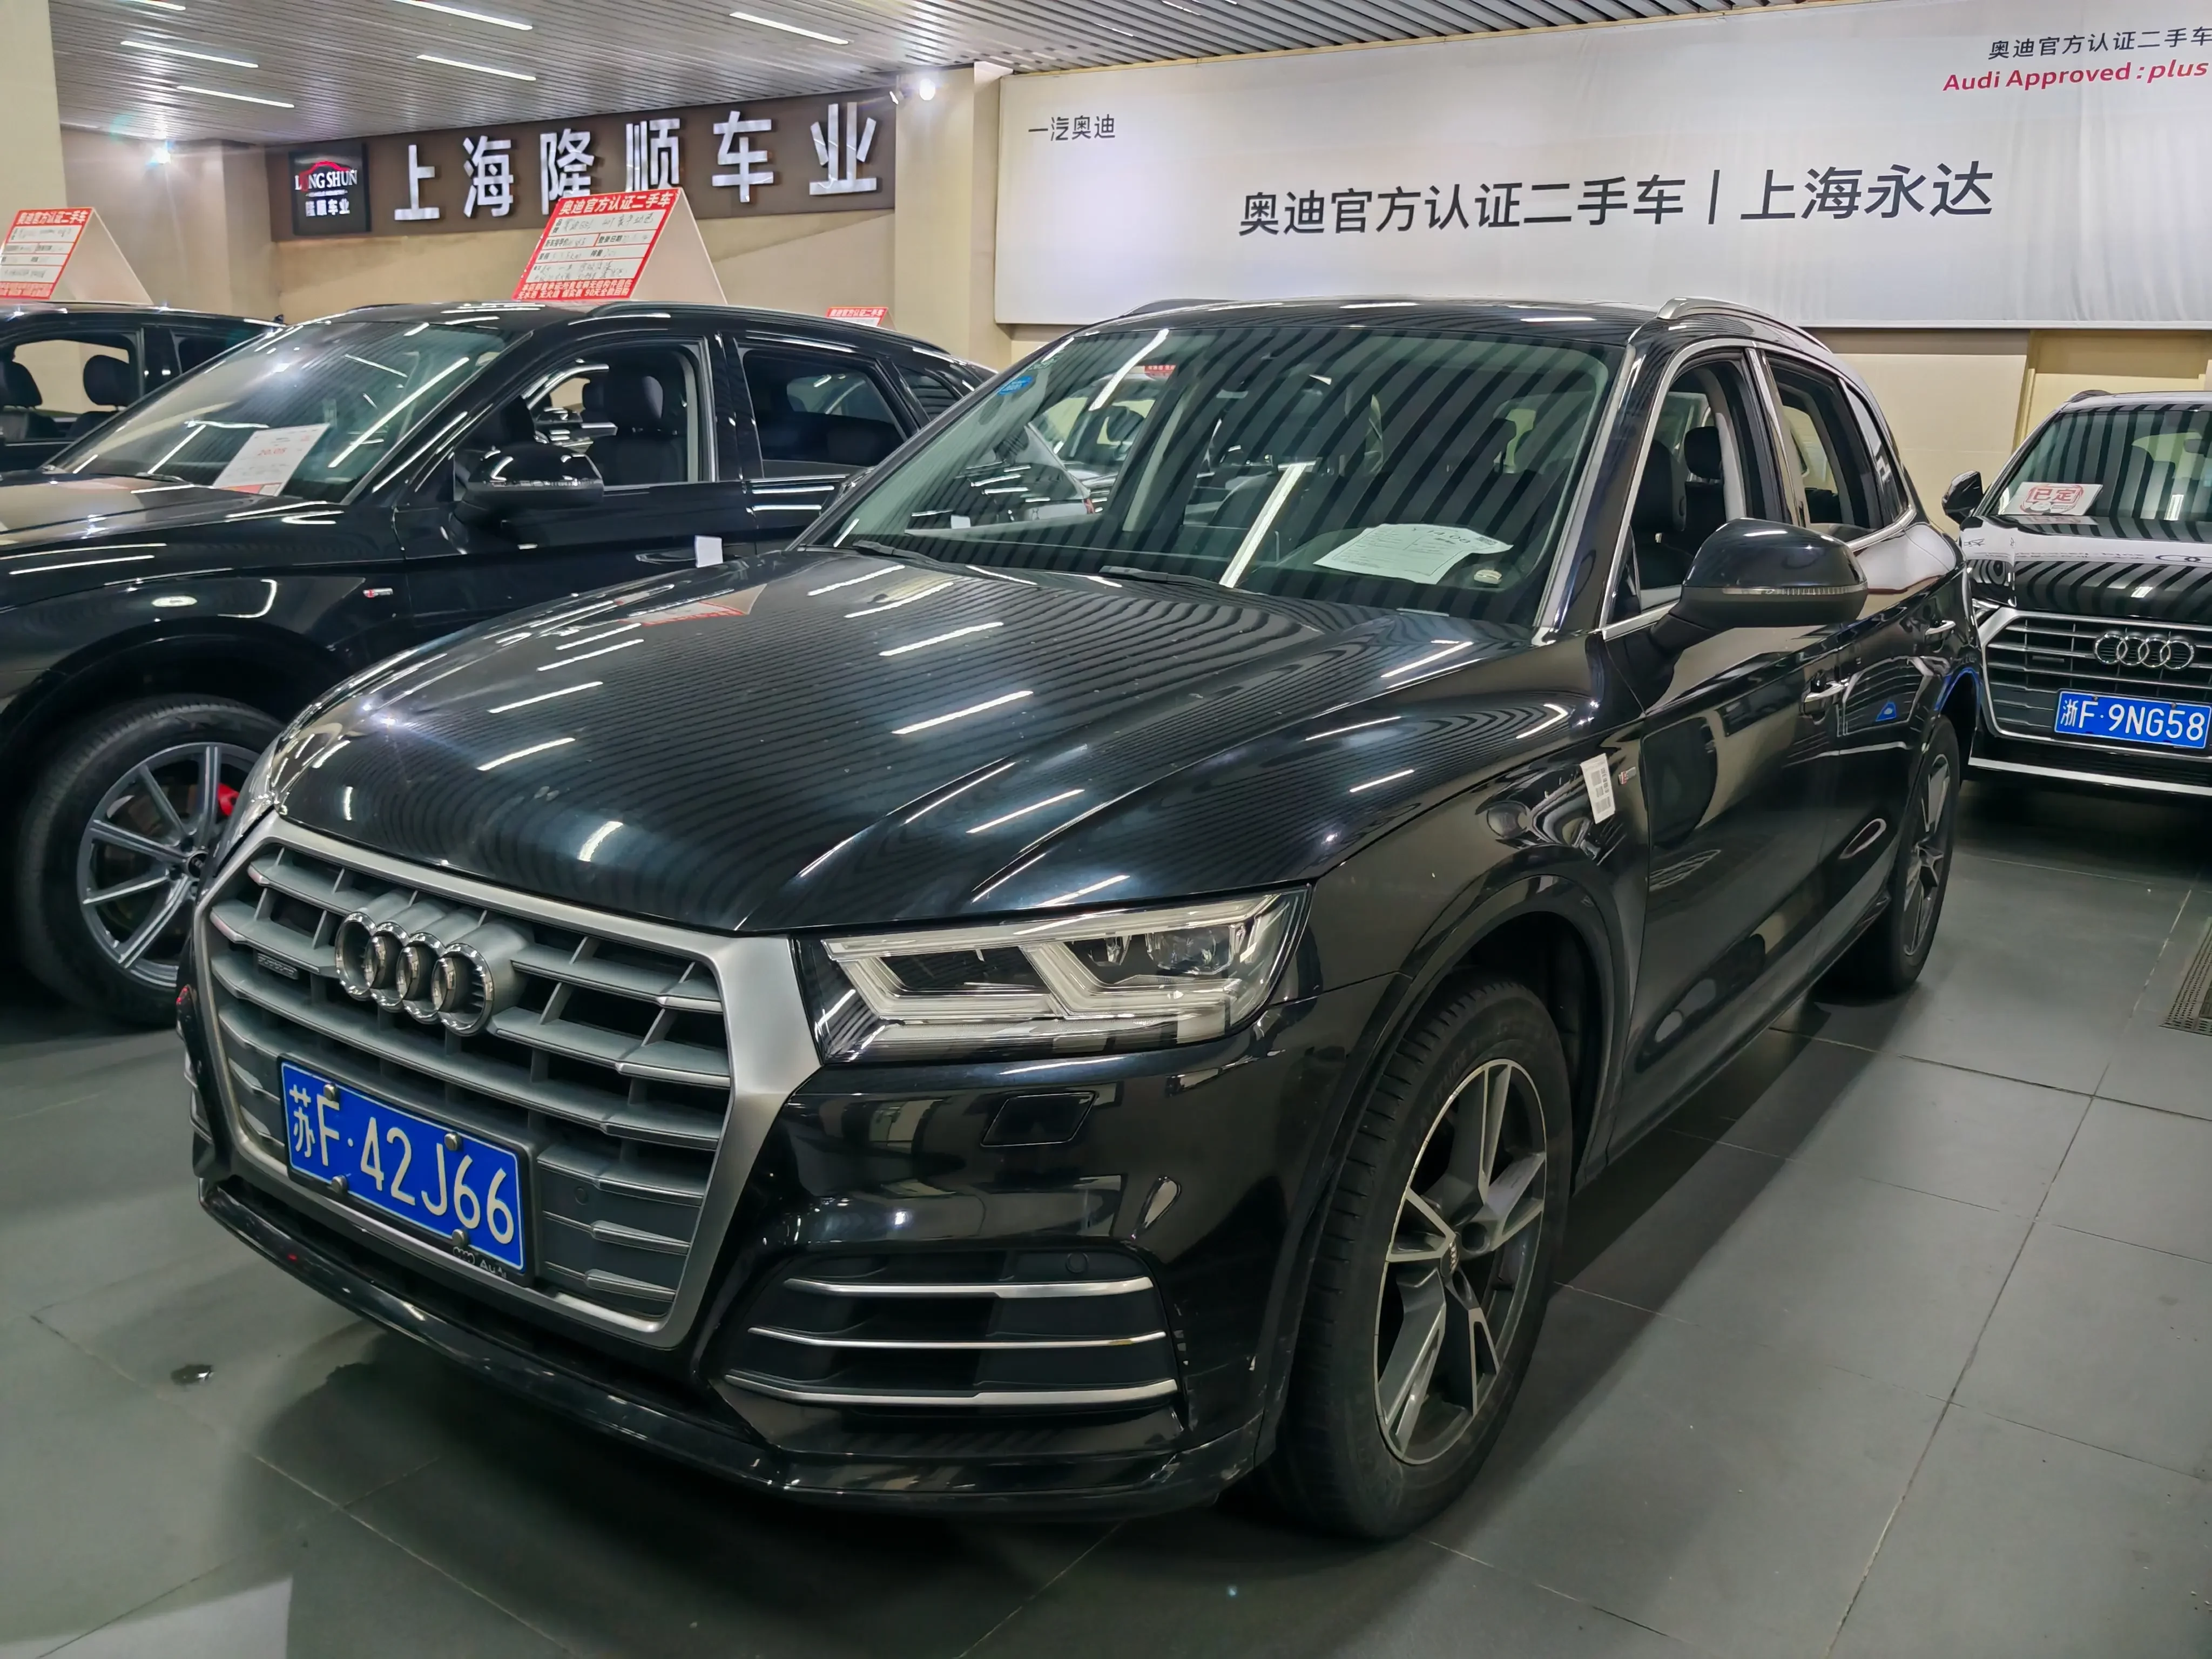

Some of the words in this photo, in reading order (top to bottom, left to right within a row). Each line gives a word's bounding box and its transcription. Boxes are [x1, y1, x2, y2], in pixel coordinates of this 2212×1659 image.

[1988, 26, 2212, 60] 奥迪官方认证二手车
[1943, 71, 2000, 91] Audi
[2006, 62, 2132, 91] Approved
[1028, 114, 1115, 141] 一汽奥迪
[394, 102, 877, 221] 上海隆顺车业
[558, 192, 675, 215] 奥迪官方认证二手车
[1239, 174, 1685, 236] 奥迪官方认证二手车
[1740, 160, 1993, 220] 上海永达
[289, 1084, 514, 1244] 苏F·42J66
